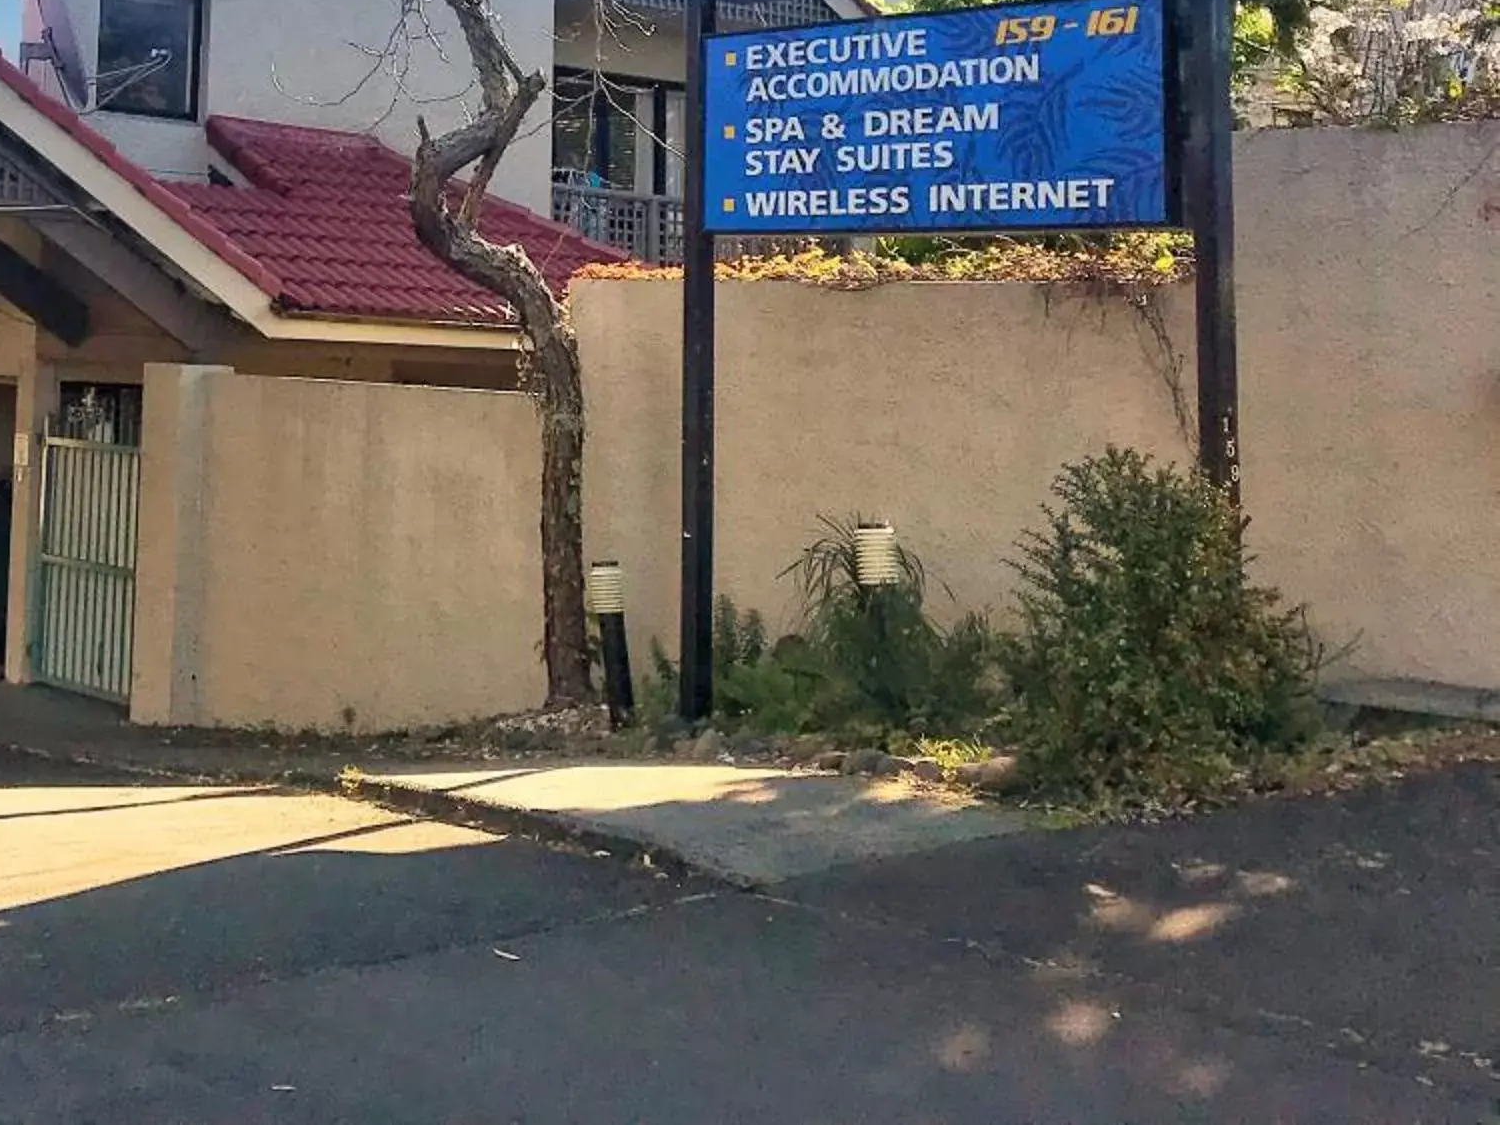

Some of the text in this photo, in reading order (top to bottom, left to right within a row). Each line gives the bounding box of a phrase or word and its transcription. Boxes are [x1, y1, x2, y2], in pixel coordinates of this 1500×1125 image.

[994, 15, 1056, 46] 159
[1086, 5, 1139, 37] 161
[745, 30, 927, 70] EXECUTIVE
[746, 53, 1040, 103] ACCOMMODATION
[745, 103, 1000, 144] SPA & DREAM
[745, 141, 955, 176] STAY SUITES
[746, 178, 1115, 217] WIRELESS INTERNET
